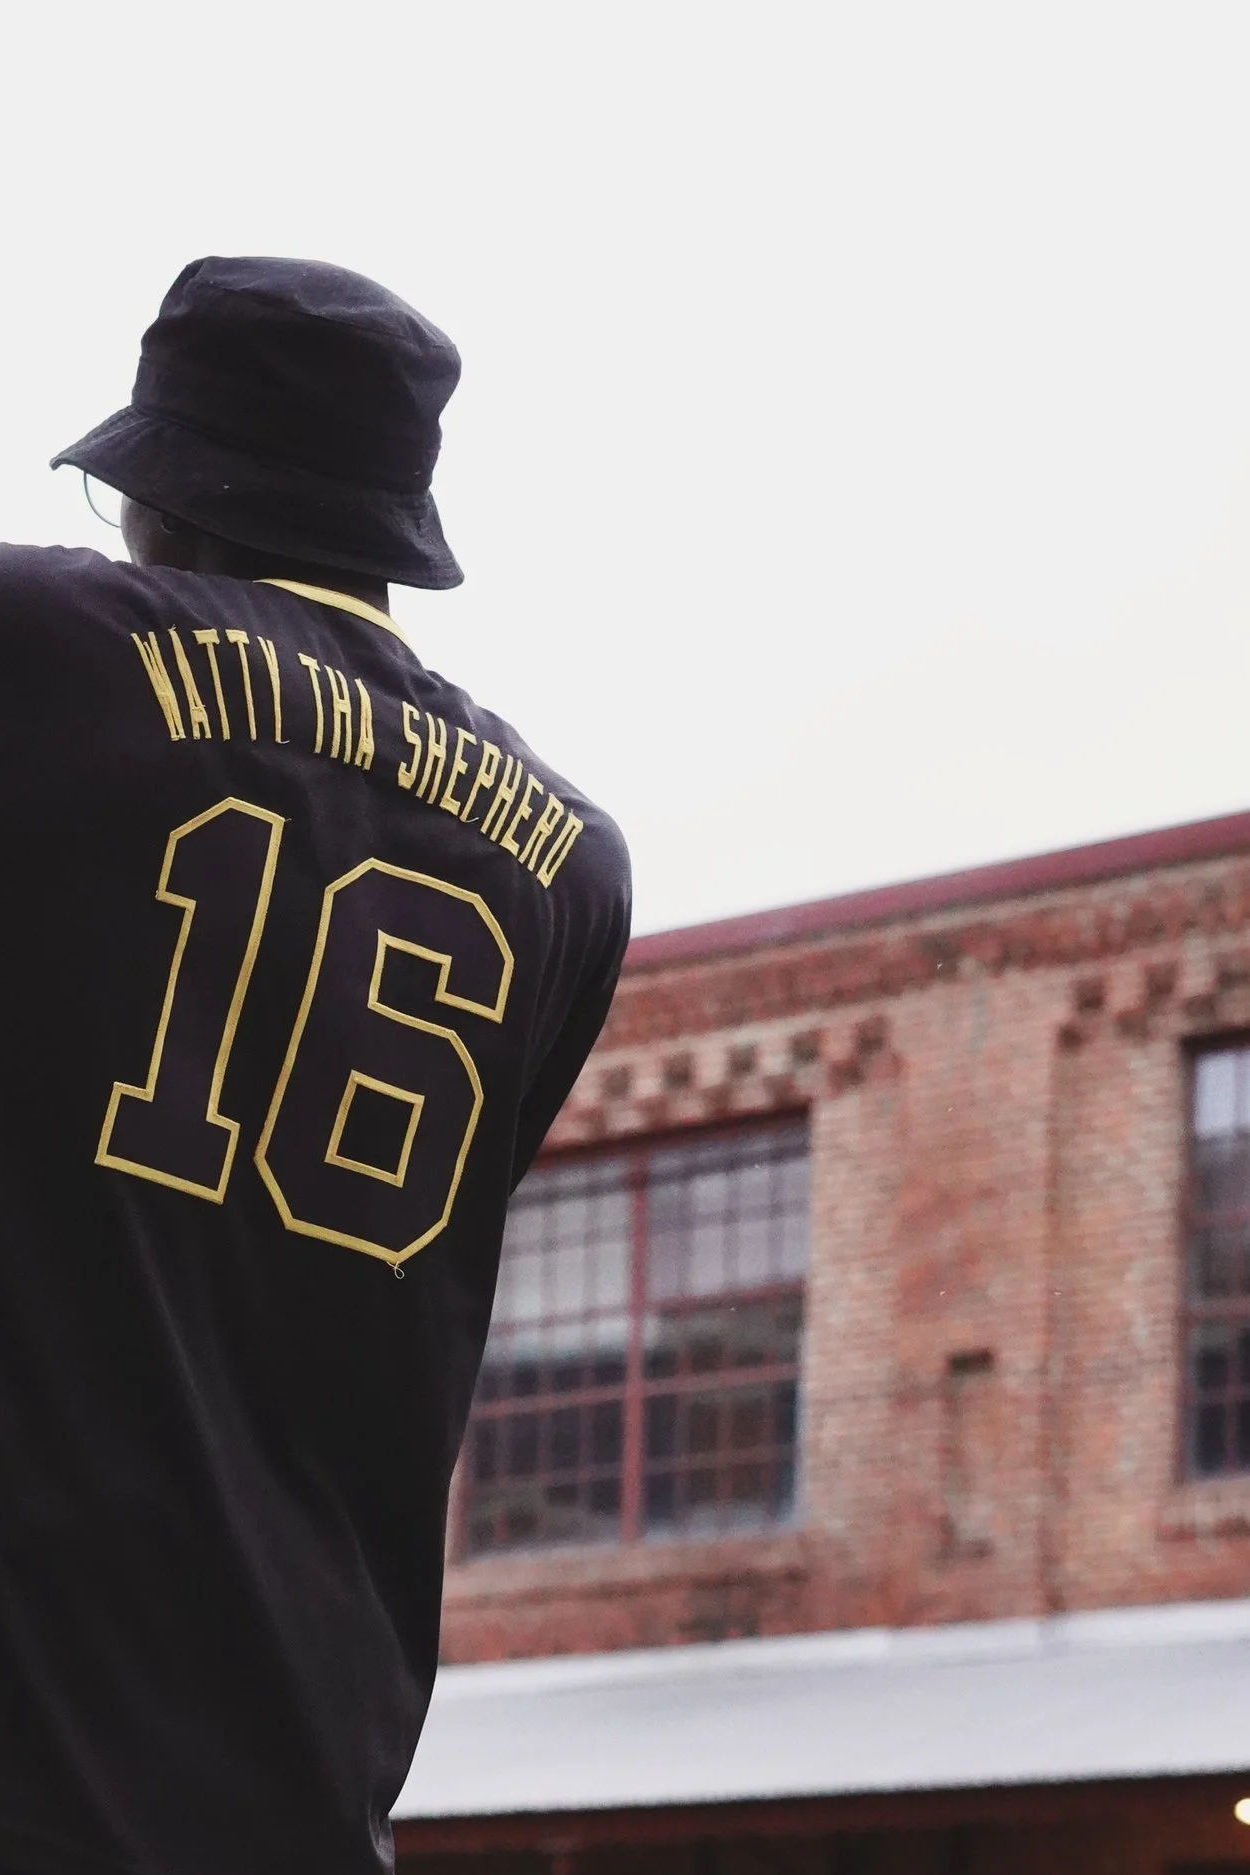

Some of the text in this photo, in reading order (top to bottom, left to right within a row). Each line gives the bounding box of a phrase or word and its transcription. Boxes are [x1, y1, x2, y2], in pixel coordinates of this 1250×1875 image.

[130, 626, 584, 890] WATTY THA SHEPHERD
[95, 796, 514, 1264] 16
